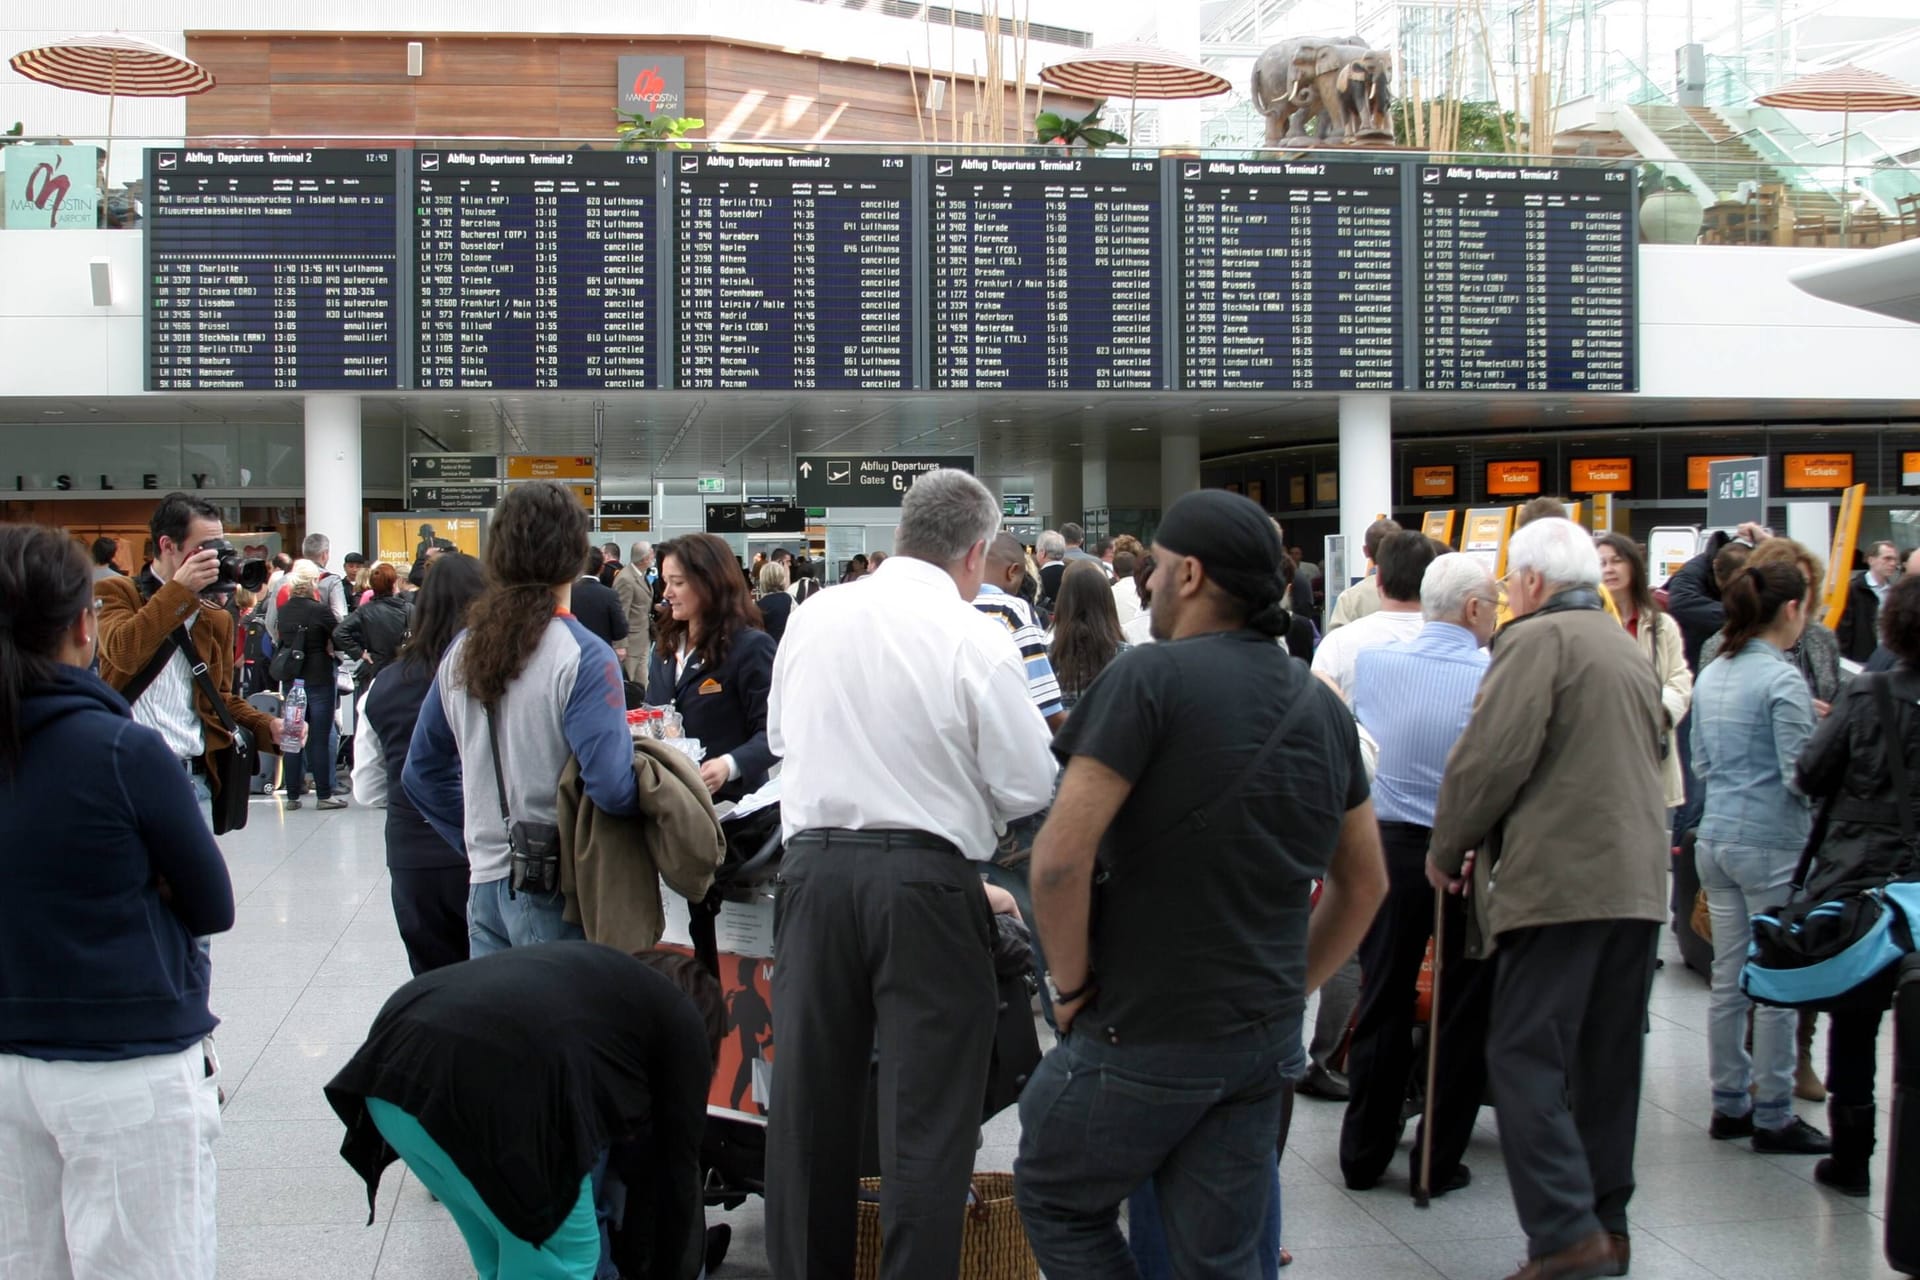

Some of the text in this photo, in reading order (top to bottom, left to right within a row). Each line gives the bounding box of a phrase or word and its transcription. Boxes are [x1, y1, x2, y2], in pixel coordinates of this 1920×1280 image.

[185, 152, 388, 164] Abflug Departures Terminal 2 12:43
[447, 153, 648, 165] Abflug Departures Terminal 2 12:43
[706, 156, 904, 168] Abflug Departures Terminal 2 12:43
[961, 159, 1153, 172] Abflug Departures Terminal 2 12:43
[1209, 163, 1235, 175] Abflug
[1239, 163, 1281, 175] Departures
[1285, 164, 1318, 174] Terminal
[1319, 165, 1325, 174] 2
[1447, 168, 1472, 180] Abflug
[1475, 168, 1517, 180] Departures
[1520, 169, 1552, 180] Terminal
[1553, 171, 1558, 180] 2
[203, 195, 216, 204] des
[296, 195, 304, 204] in
[309, 195, 335, 204] Island
[681, 198, 690, 206] LH
[720, 198, 746, 207] Berlin
[794, 199, 814, 207] 14:35
[861, 200, 899, 208] cancelled
[421, 207, 430, 215] LH
[461, 208, 496, 216] Toulouse
[536, 208, 557, 216] 13:10
[604, 208, 639, 217] boarding
[936, 212, 945, 220] LH
[975, 212, 996, 220] Turin
[1046, 213, 1067, 221] 14:55
[1112, 213, 1149, 222] Lufthansa
[681, 220, 690, 229] LH
[720, 221, 737, 229] Linz
[794, 221, 814, 230] 14:35
[861, 222, 899, 231] Lufthansa
[936, 234, 945, 242] LH
[974, 234, 1008, 243] Florence
[1046, 235, 1067, 243] 15:00
[1112, 235, 1149, 244] Lufthansa
[159, 264, 169, 272] LH
[199, 264, 239, 272] Charlotte
[274, 264, 296, 272] 11:40
[300, 264, 322, 272] 13:45
[344, 264, 383, 272] Lufthansa
[421, 276, 430, 284] LH
[461, 276, 492, 284] Trieste
[536, 276, 557, 284] 13:15
[604, 277, 644, 285] Lufthansa
[1186, 280, 1194, 289] LH
[1354, 283, 1392, 291] cancelled
[681, 288, 690, 297] LH
[720, 288, 763, 297] Copenhagen
[794, 289, 815, 297] 14:45
[861, 289, 900, 298] cancelled
[159, 322, 168, 330] LH
[274, 322, 296, 330] 13:05
[344, 321, 387, 330] annulliert
[1186, 336, 1194, 344] LH
[1223, 336, 1264, 344] Gothenburg
[1355, 337, 1392, 345] cancelled
[860, 460, 940, 473] Abflug Departures
[1588, 472, 1619, 481] Tickets
[1804, 467, 1839, 477] Tickets
[1424, 478, 1446, 486] Tickets
[1502, 474, 1529, 483] Tickets
[860, 475, 885, 487] Gates
[892, 475, 908, 493] G,
[380, 549, 409, 561] Airport
